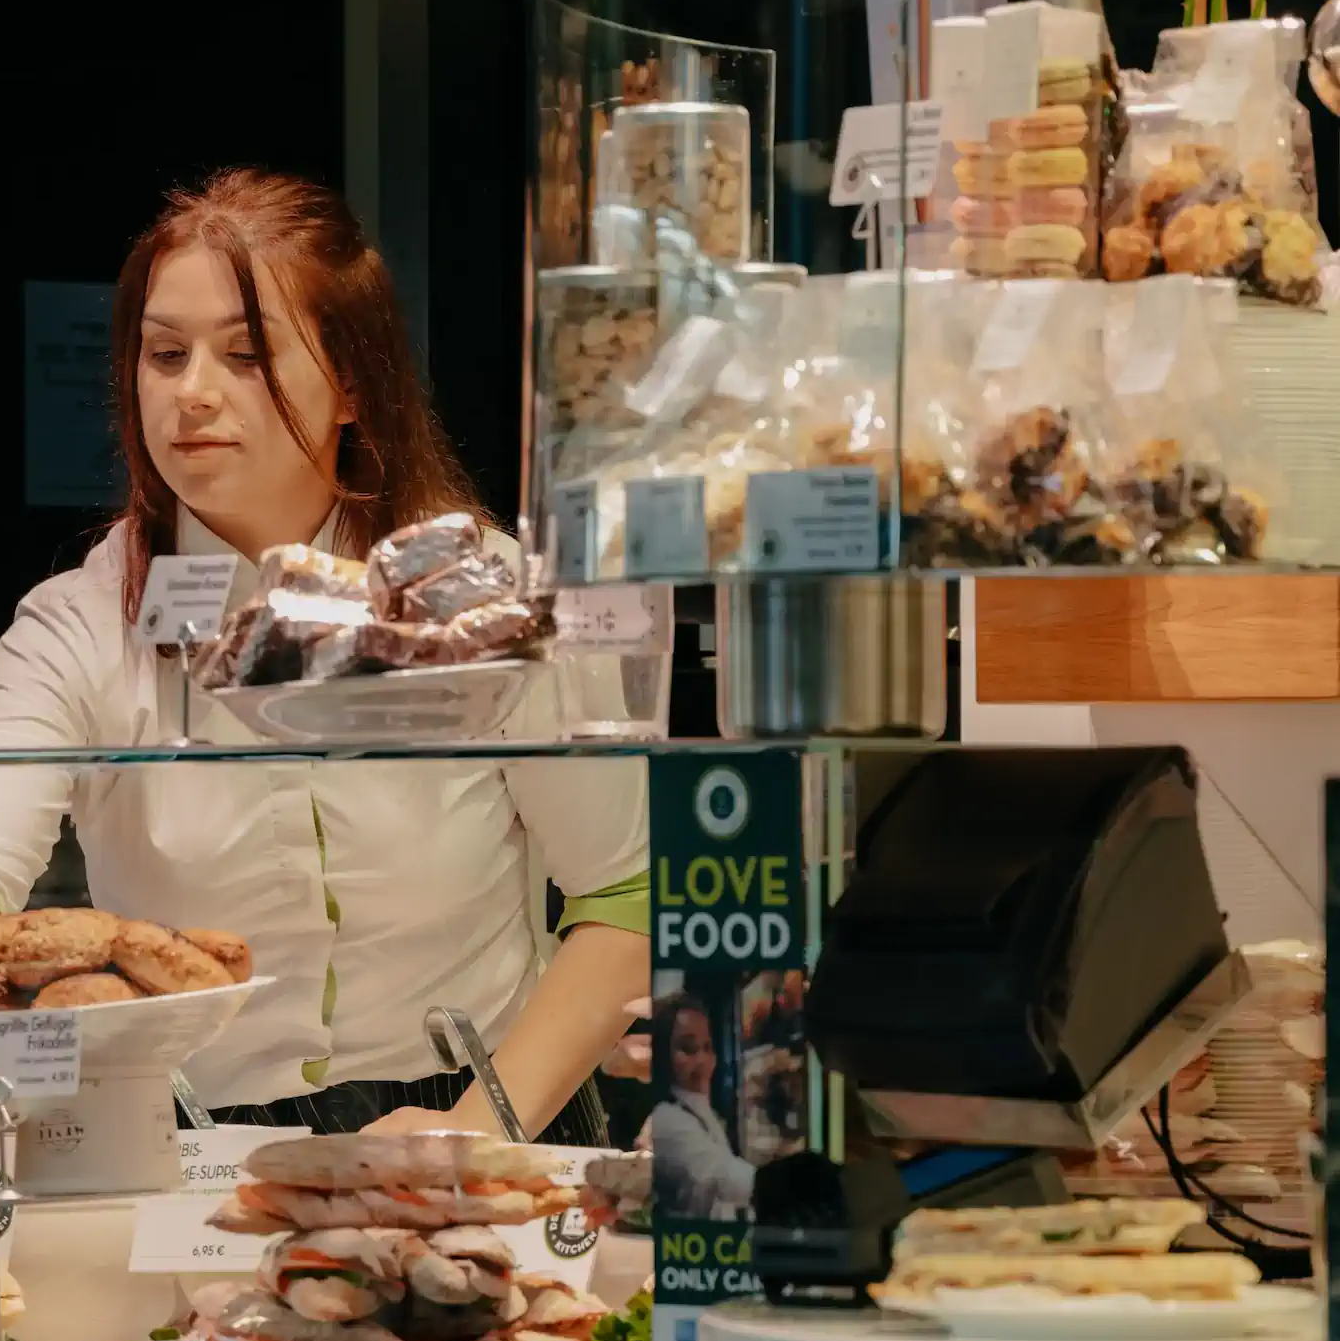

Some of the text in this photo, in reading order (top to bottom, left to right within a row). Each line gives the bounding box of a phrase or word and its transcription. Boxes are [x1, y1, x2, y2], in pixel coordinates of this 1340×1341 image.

[657, 855, 790, 908] LOVE
[656, 911, 792, 961] FOOD
[192, 1244, 227, 1259] 6,95 €
[553, 1231, 598, 1255] KITCHEN
[661, 1232, 753, 1265] NO CA
[661, 1266, 720, 1292] ONLY
